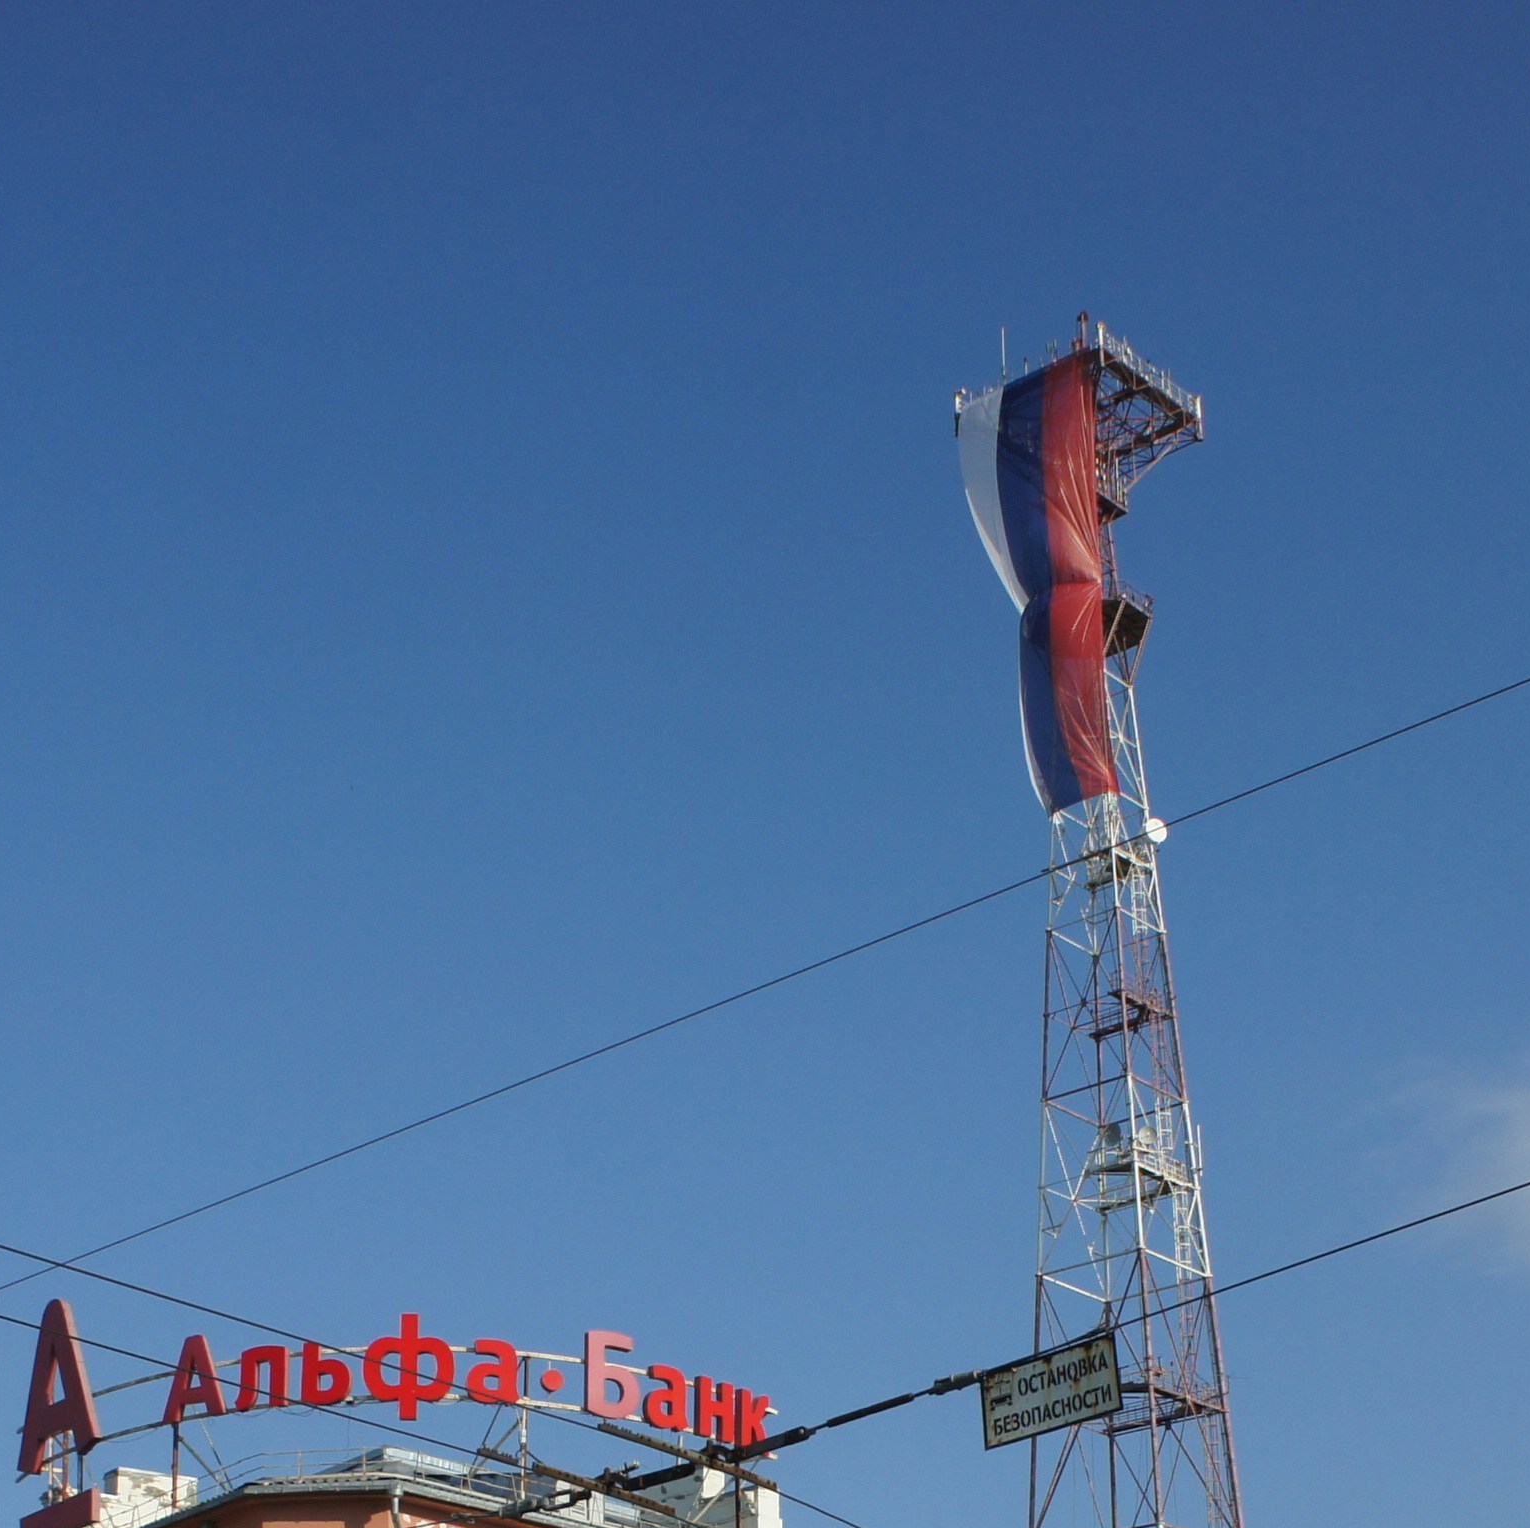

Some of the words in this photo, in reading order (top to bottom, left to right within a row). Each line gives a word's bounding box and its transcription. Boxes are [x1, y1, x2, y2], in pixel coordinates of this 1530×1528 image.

[163, 1313, 518, 1424] Альфа
[584, 1329, 774, 1450] Банк
[1018, 1351, 1109, 1397] ОСТАНОВКА
[993, 1384, 1113, 1437] БЕЗОПАСНОСТИ
